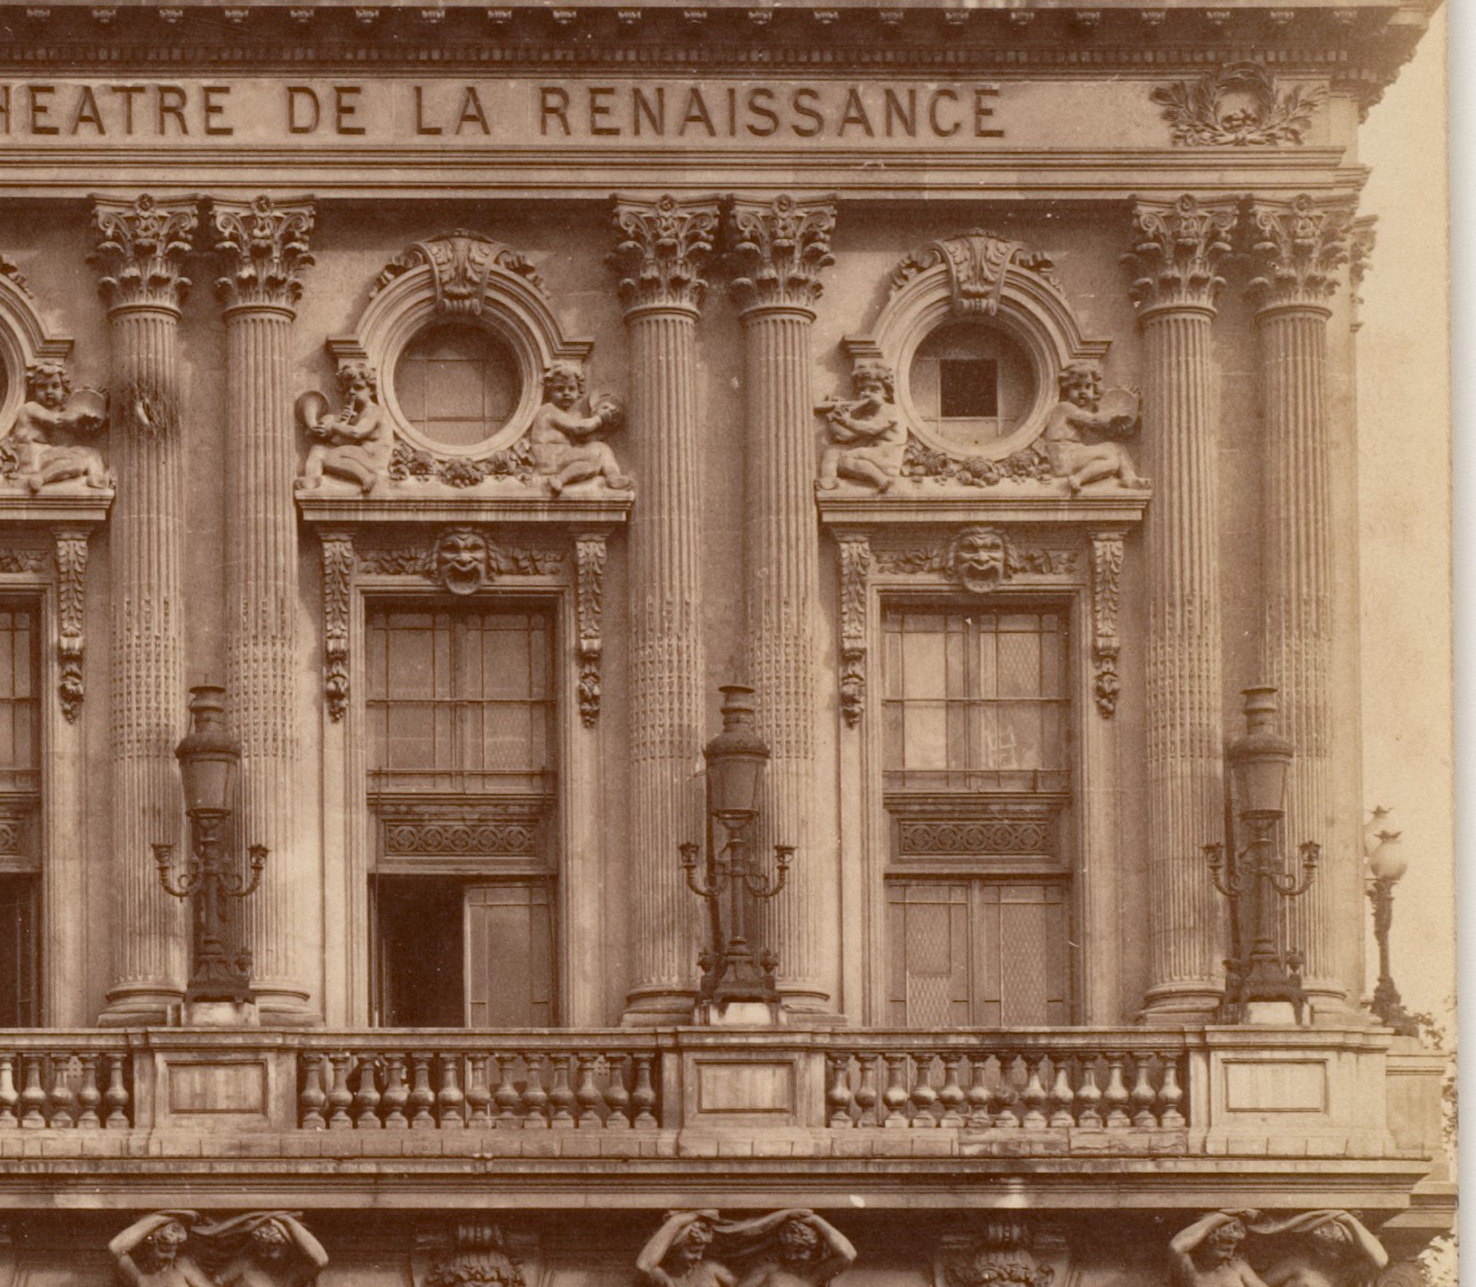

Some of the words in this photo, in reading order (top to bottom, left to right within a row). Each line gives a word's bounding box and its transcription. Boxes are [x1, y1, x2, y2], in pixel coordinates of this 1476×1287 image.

[287, 85, 367, 136] DE
[414, 85, 491, 136] LA
[538, 85, 1006, 139] RENAISSANCE
